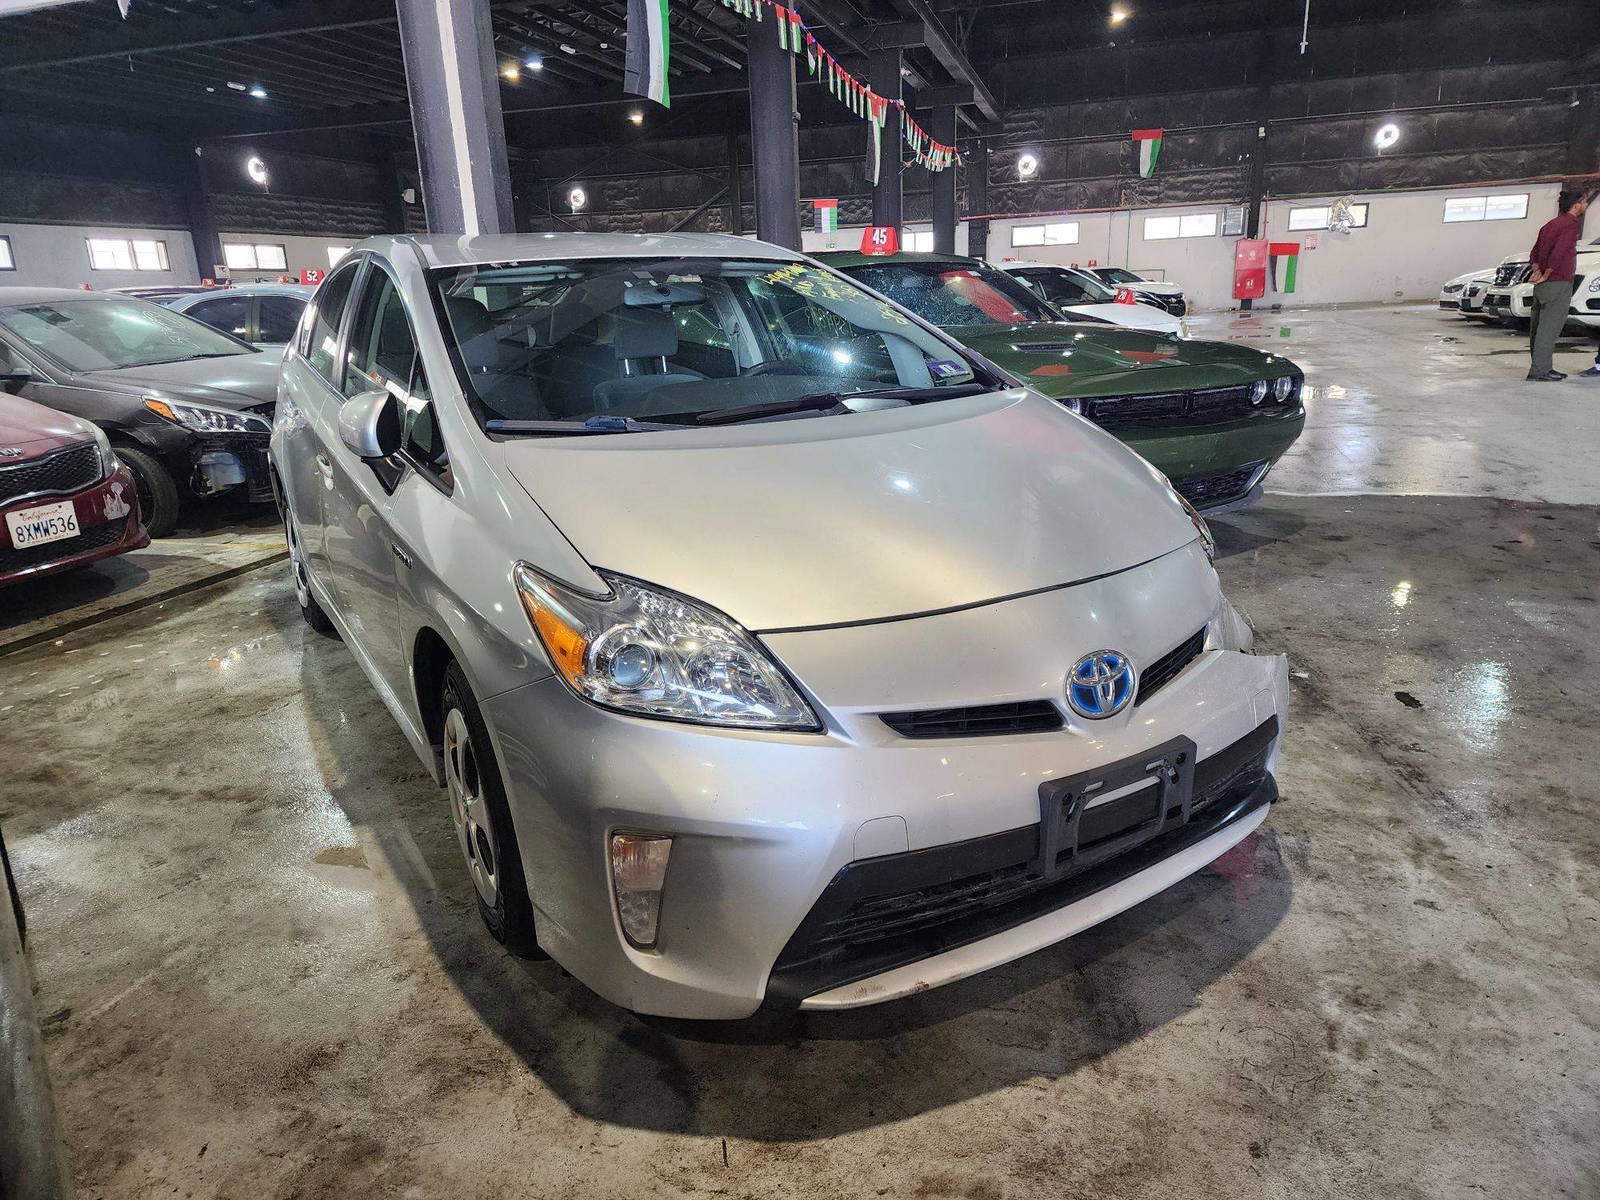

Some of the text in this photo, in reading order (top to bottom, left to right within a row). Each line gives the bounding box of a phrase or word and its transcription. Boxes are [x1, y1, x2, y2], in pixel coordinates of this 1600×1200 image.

[872, 229, 887, 245] 45
[306, 270, 318, 282] 52
[15, 515, 76, 543] 8XMW536
